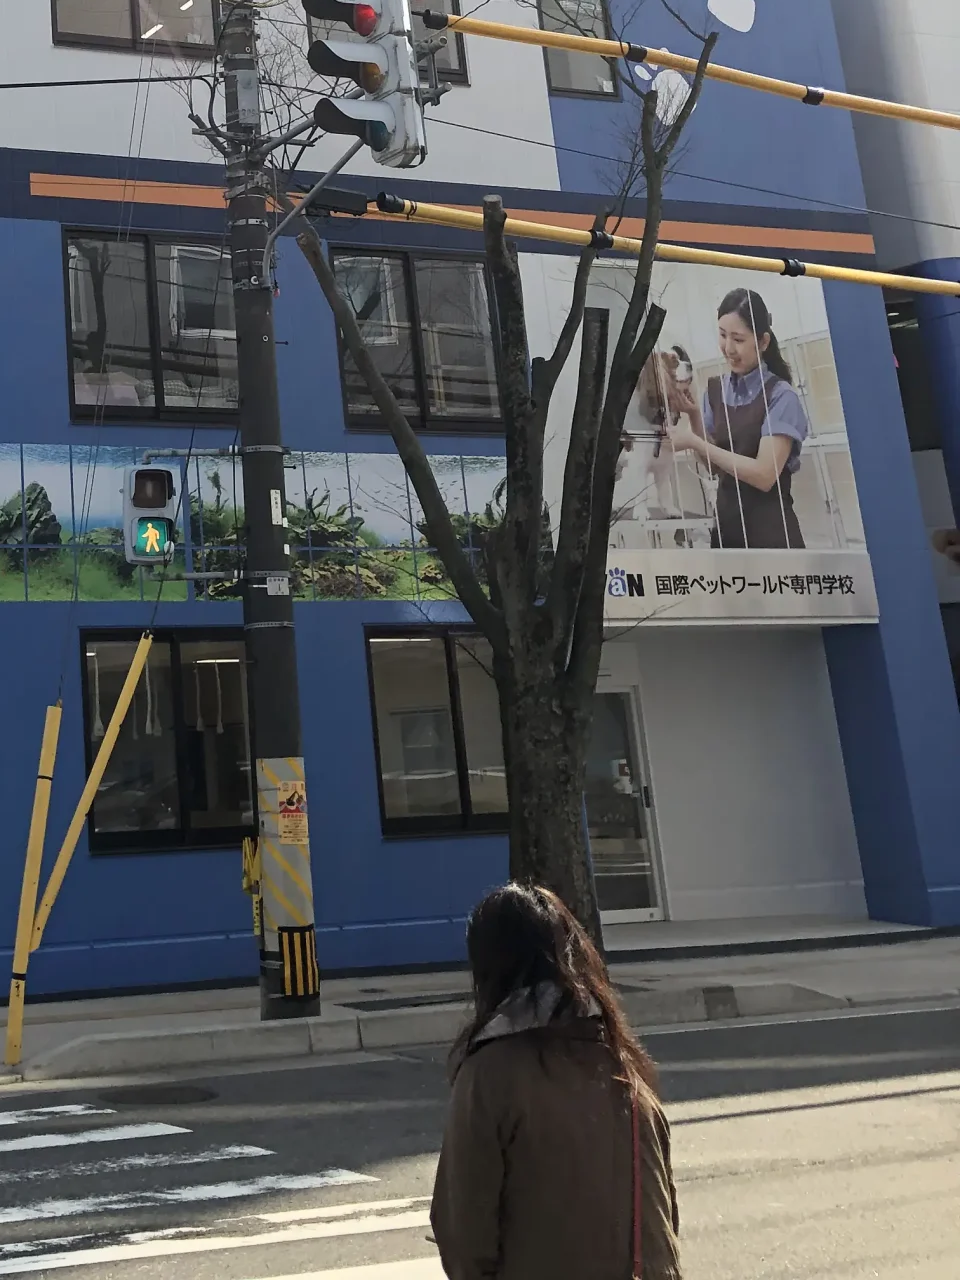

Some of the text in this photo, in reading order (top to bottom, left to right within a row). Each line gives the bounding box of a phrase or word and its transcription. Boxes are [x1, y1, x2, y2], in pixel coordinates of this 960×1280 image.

[605, 568, 855, 597] aN 国際ペットワールド専門学校
